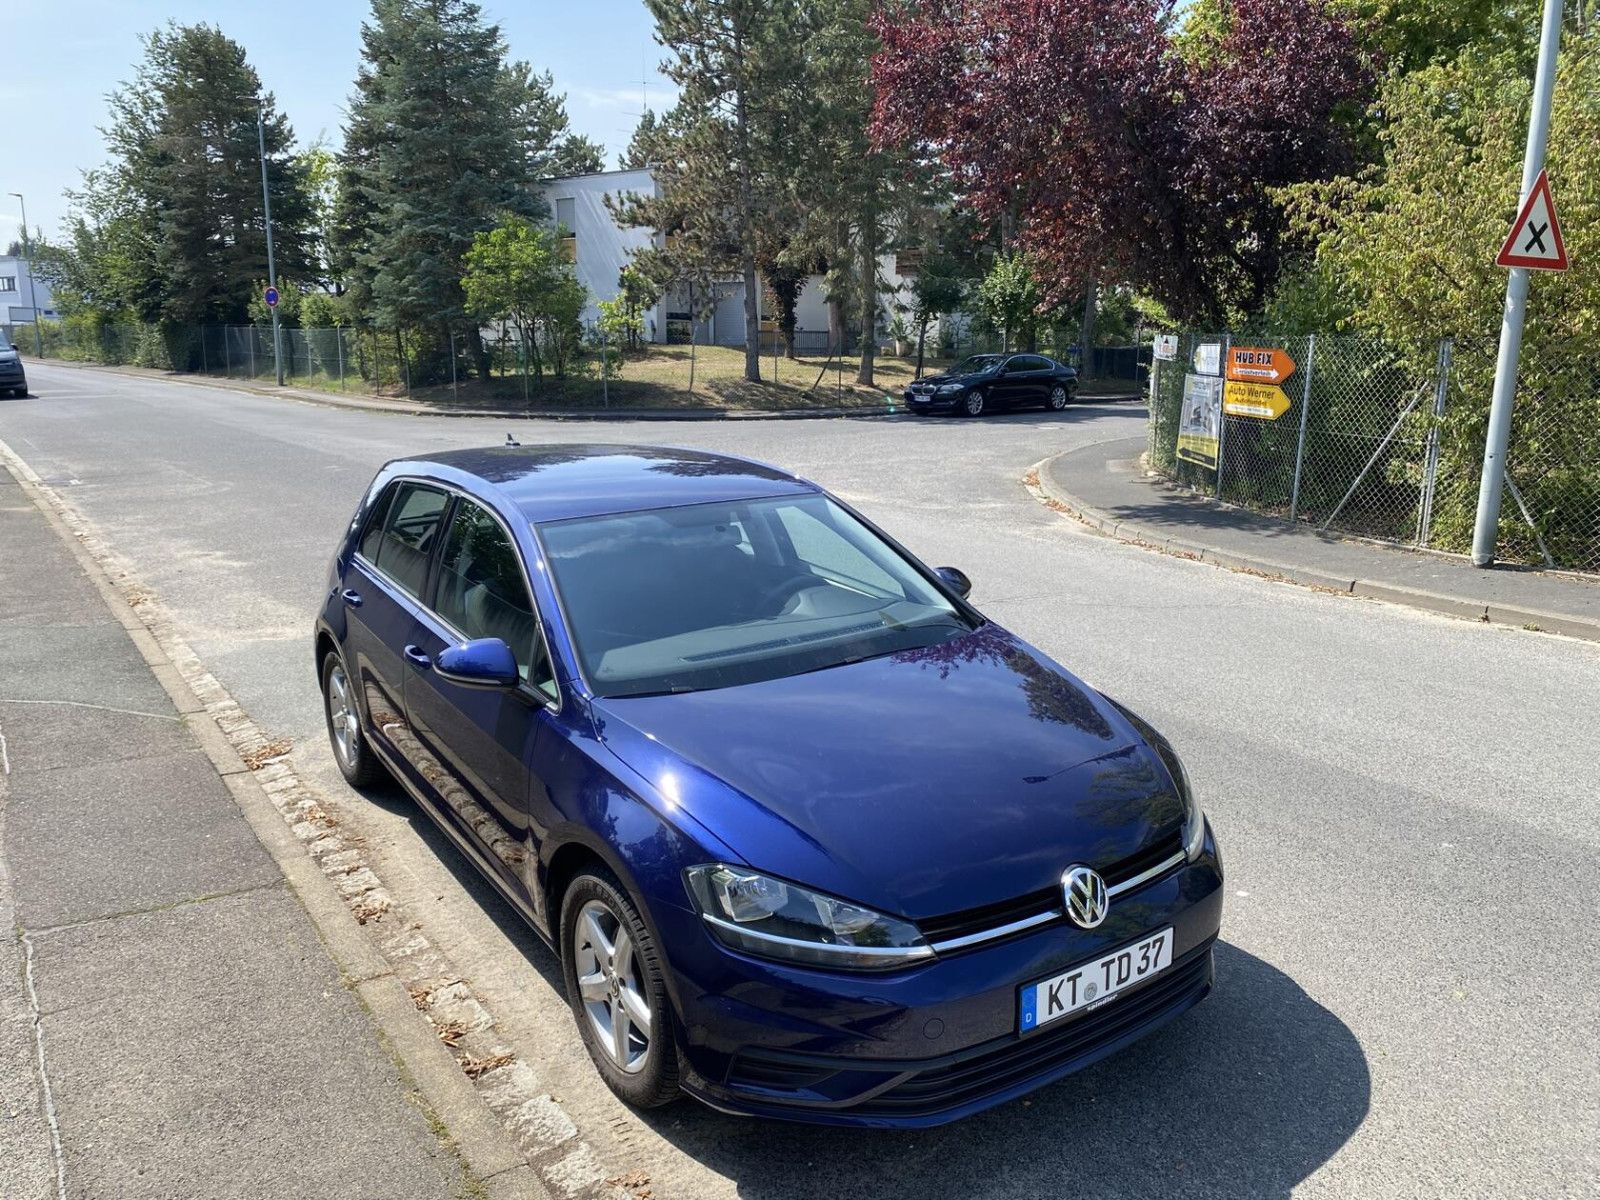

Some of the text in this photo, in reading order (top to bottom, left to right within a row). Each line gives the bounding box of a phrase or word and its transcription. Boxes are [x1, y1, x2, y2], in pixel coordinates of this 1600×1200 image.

[1235, 351, 1273, 365] HUB FIX
[1228, 385, 1275, 399] Auto Werner
[1025, 935, 1165, 1023] D KT TD 37
